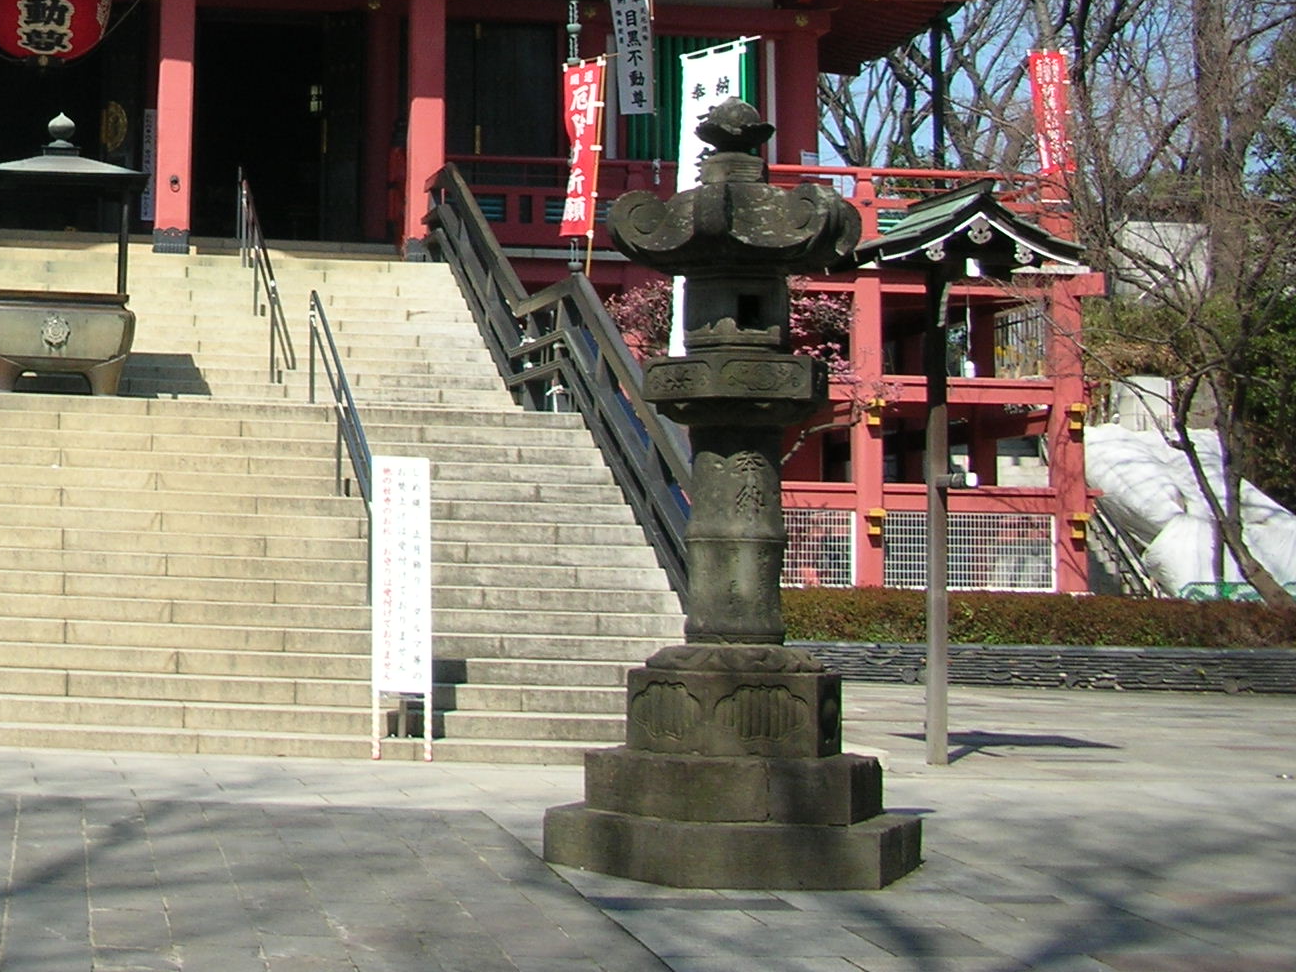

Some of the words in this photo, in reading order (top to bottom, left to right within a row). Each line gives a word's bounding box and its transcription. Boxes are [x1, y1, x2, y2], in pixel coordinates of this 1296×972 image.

[625, 9, 647, 108] 目黒不動尊
